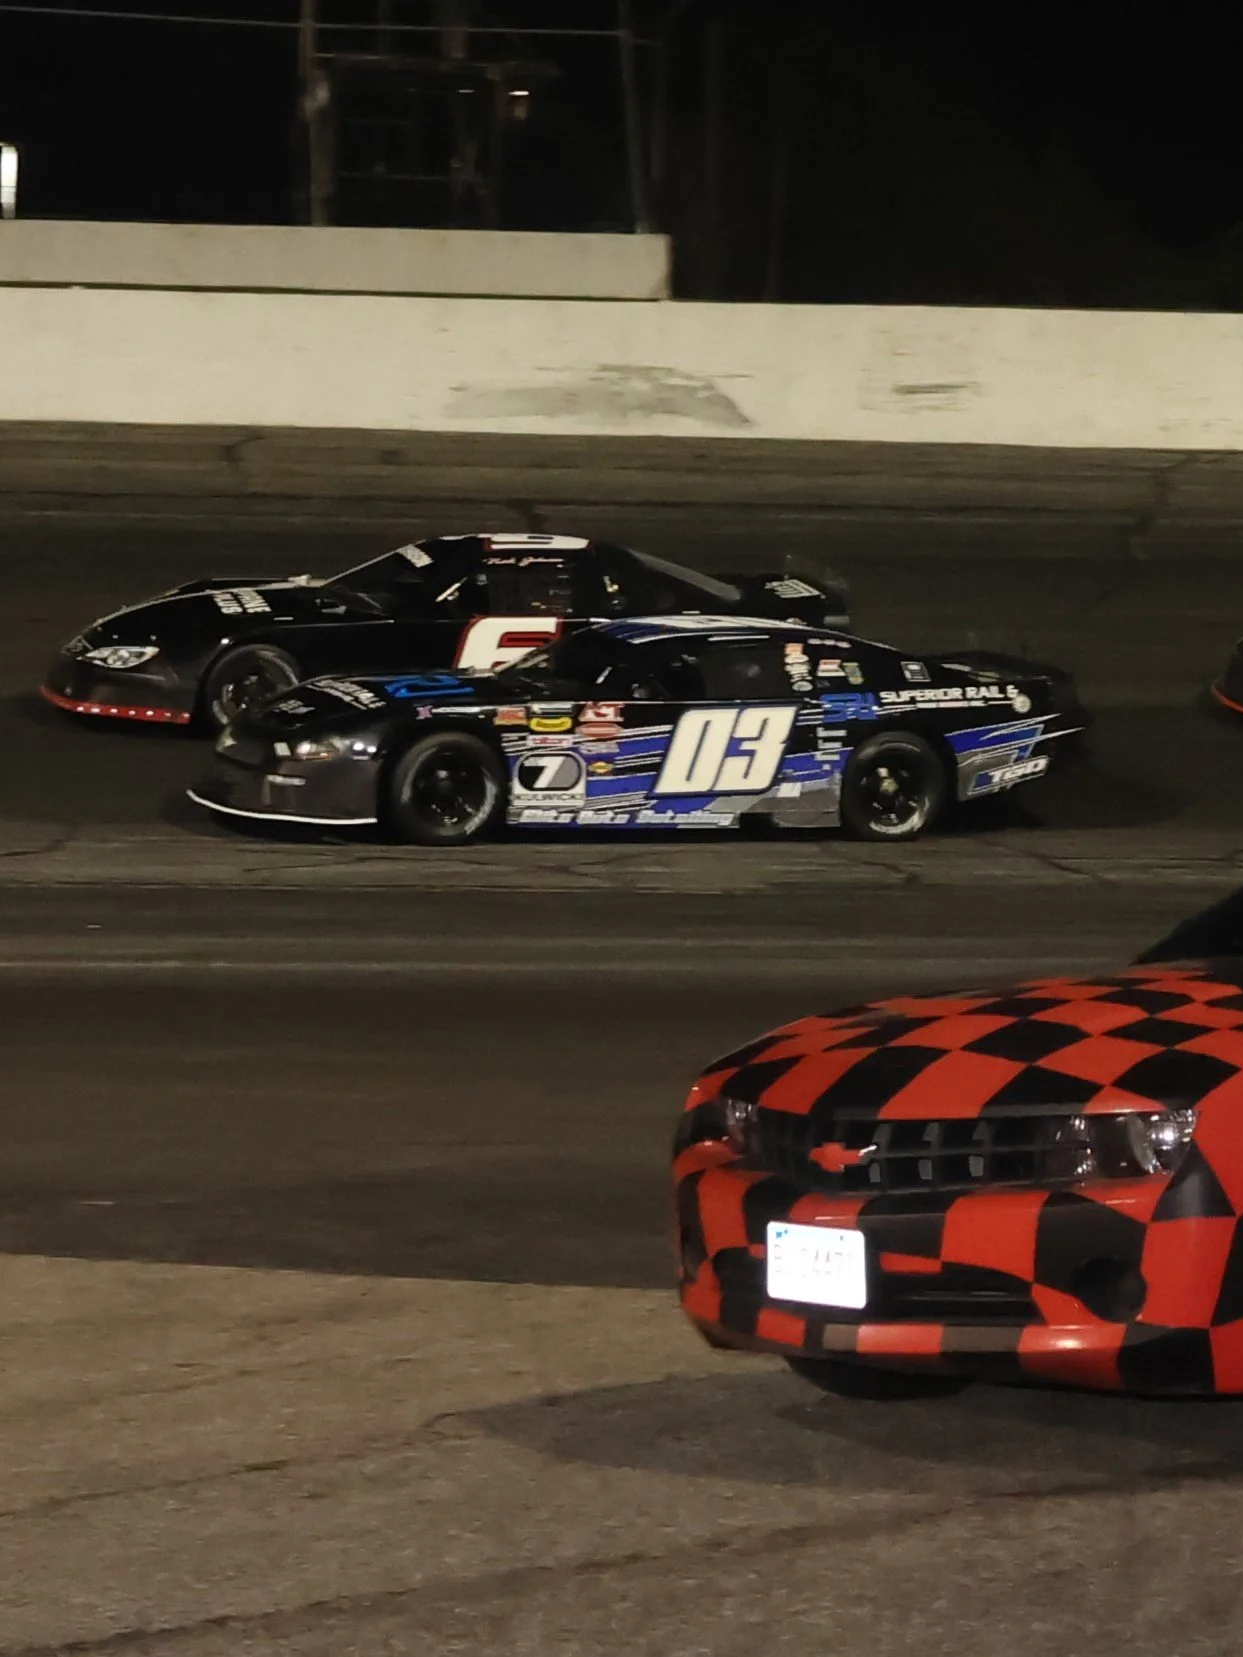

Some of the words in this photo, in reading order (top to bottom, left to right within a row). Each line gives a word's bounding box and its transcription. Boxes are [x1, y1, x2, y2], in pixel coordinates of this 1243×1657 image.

[879, 688, 963, 703] SUPERIOR
[965, 686, 1004, 699] RAIL
[653, 705, 798, 796] 03
